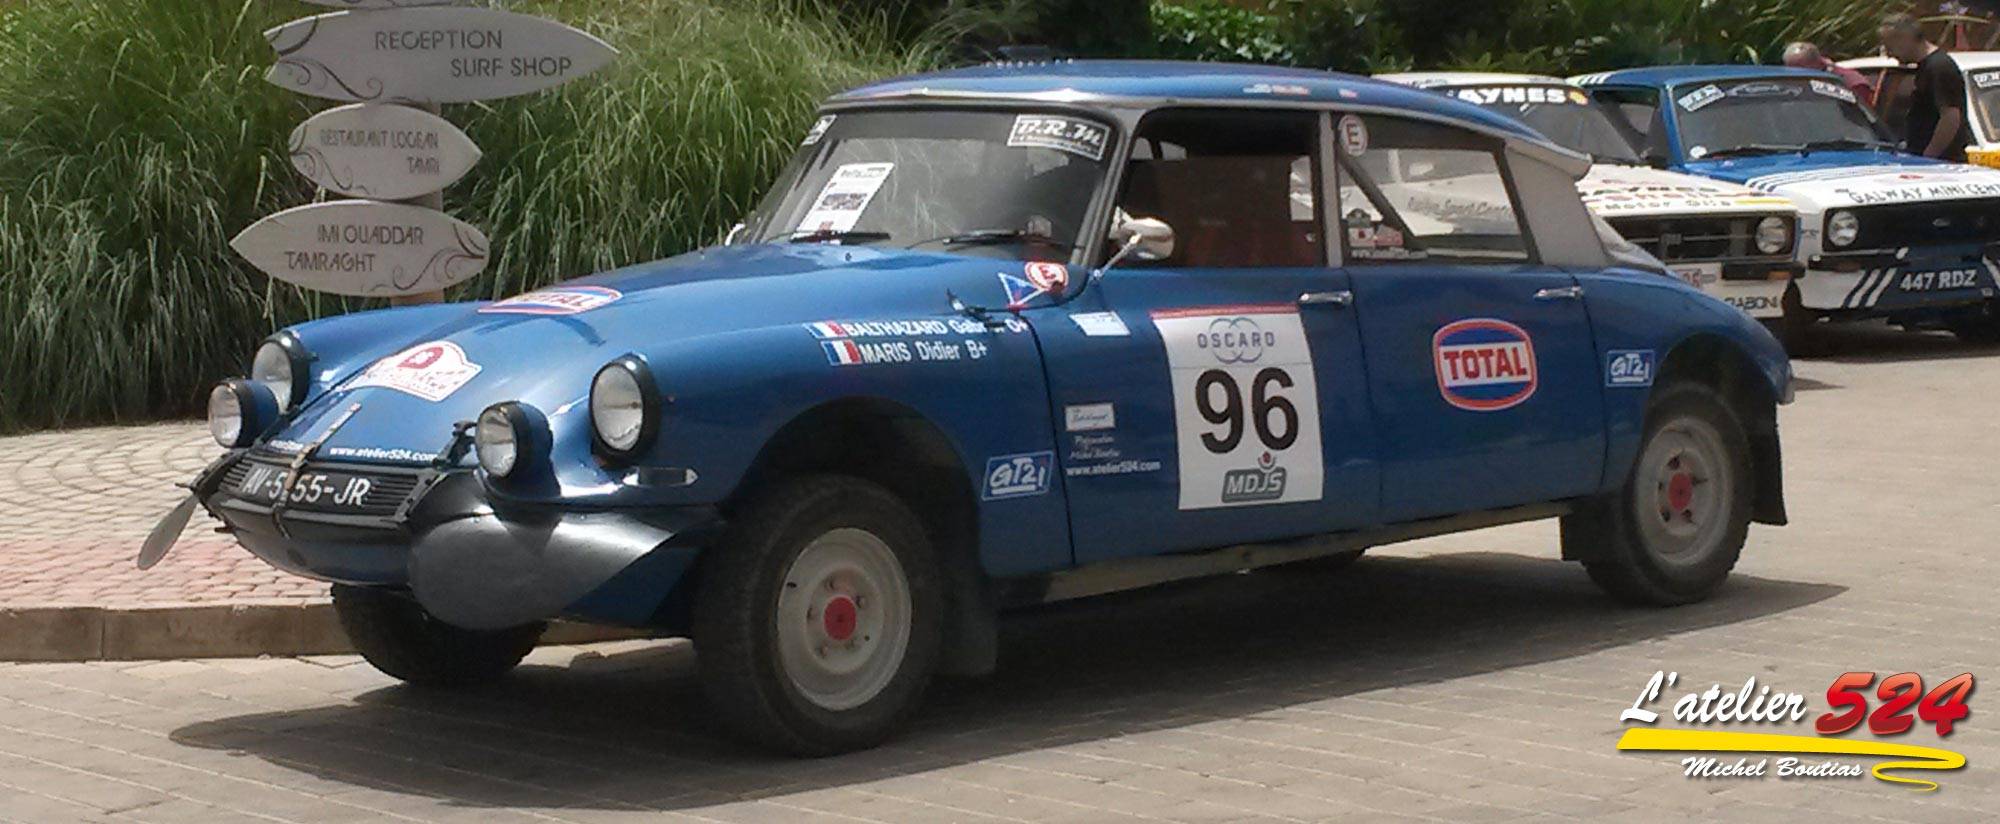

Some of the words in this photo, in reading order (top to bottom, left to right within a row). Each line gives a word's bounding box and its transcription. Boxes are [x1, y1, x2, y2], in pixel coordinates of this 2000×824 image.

[375, 30, 502, 50] RECEPTION
[450, 58, 503, 77] SURF
[511, 57, 571, 77] SHOP
[1850, 187, 1922, 204] GALWAY
[1928, 184, 1965, 197] MINI
[318, 224, 339, 243] IMI
[284, 251, 376, 272] TAMRAGHT
[1900, 271, 1934, 291] 447
[1938, 269, 1976, 288] RDZ
[843, 320, 949, 336] BALTHAZARD
[1197, 333, 1275, 348] OSCARO
[861, 343, 911, 363] MARIS
[915, 341, 960, 360] Didier
[965, 339, 987, 359] B+
[1444, 343, 1526, 380] TOTAL
[1195, 367, 1298, 453] 96
[1227, 472, 1283, 493] MDJS
